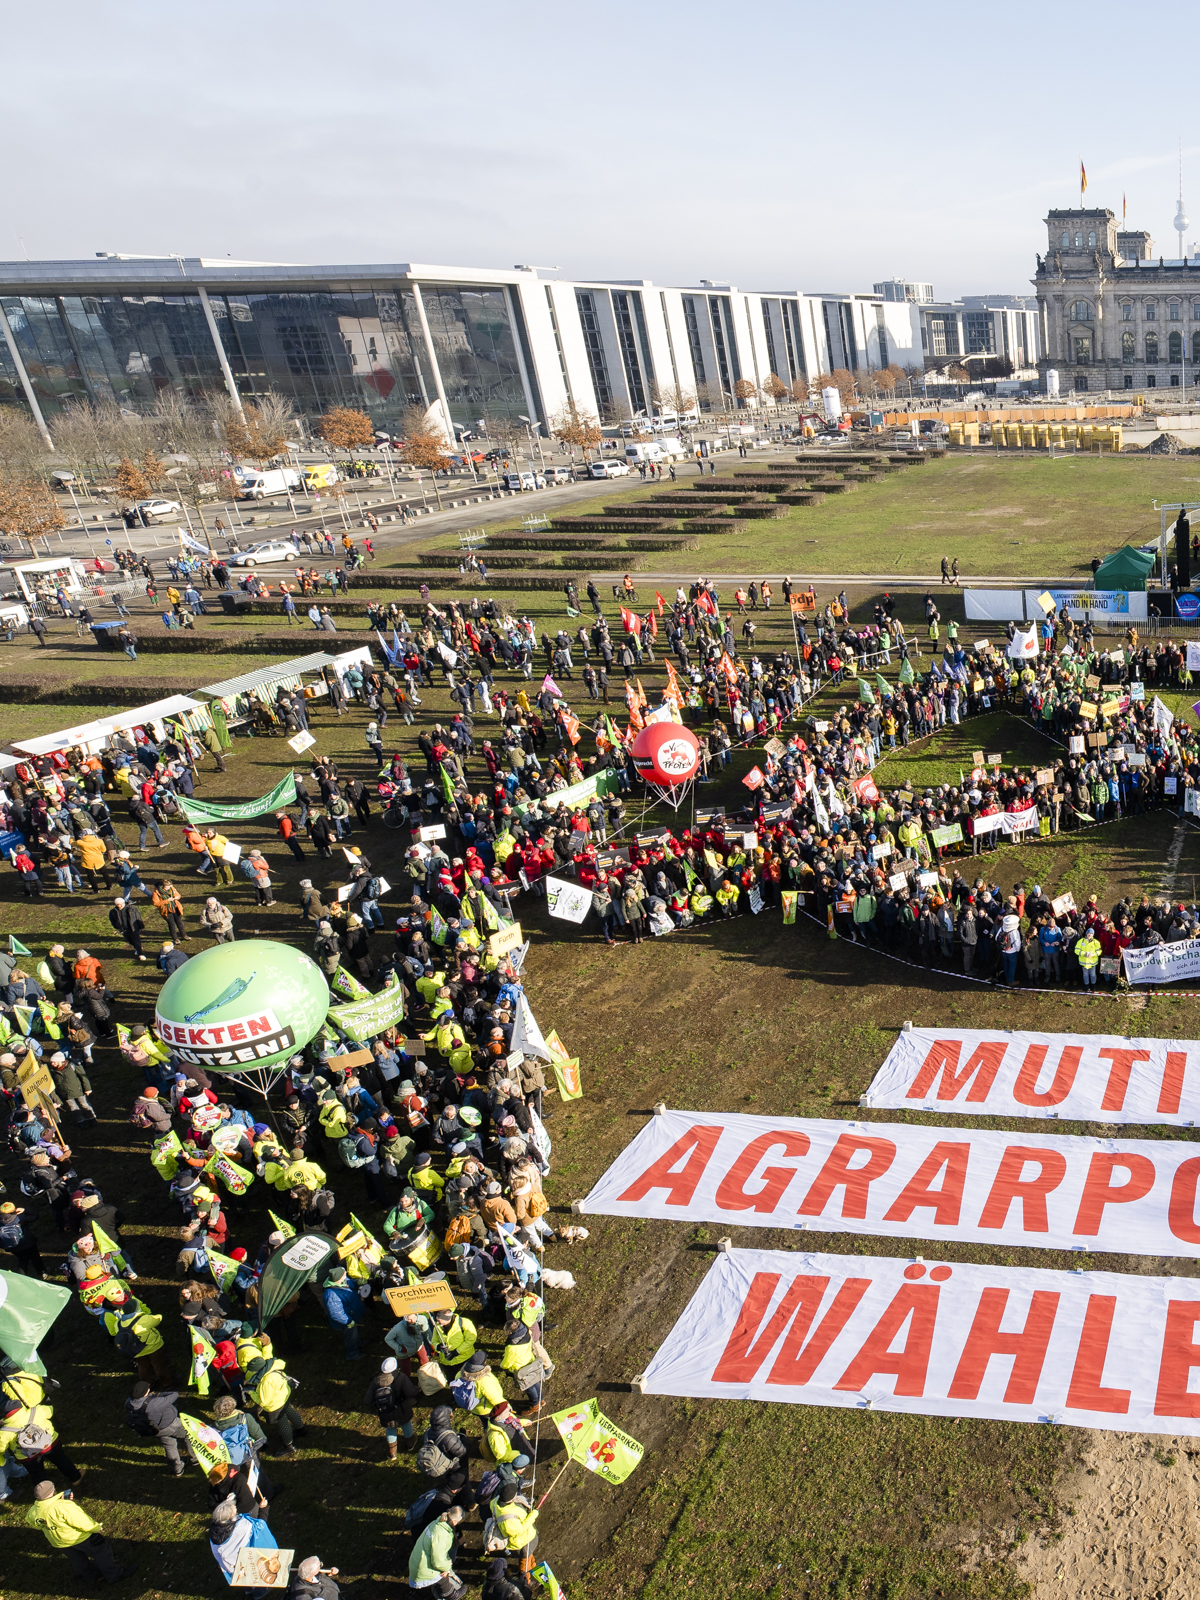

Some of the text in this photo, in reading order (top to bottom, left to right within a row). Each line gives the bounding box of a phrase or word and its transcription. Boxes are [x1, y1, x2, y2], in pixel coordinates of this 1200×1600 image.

[1062, 600, 1108, 609] HAND IN HAND
[1012, 819, 1035, 830] NAJU
[498, 932, 514, 944] Fürth
[341, 1010, 374, 1030] BLEIBT
[377, 1002, 394, 1016] BEI
[353, 1022, 375, 1037] VOM
[290, 1257, 306, 1268] BUND
[389, 1284, 447, 1300] Forchheim
[598, 1417, 644, 1454] TIERFABRIKEN?
[607, 1471, 620, 1481] BUND
